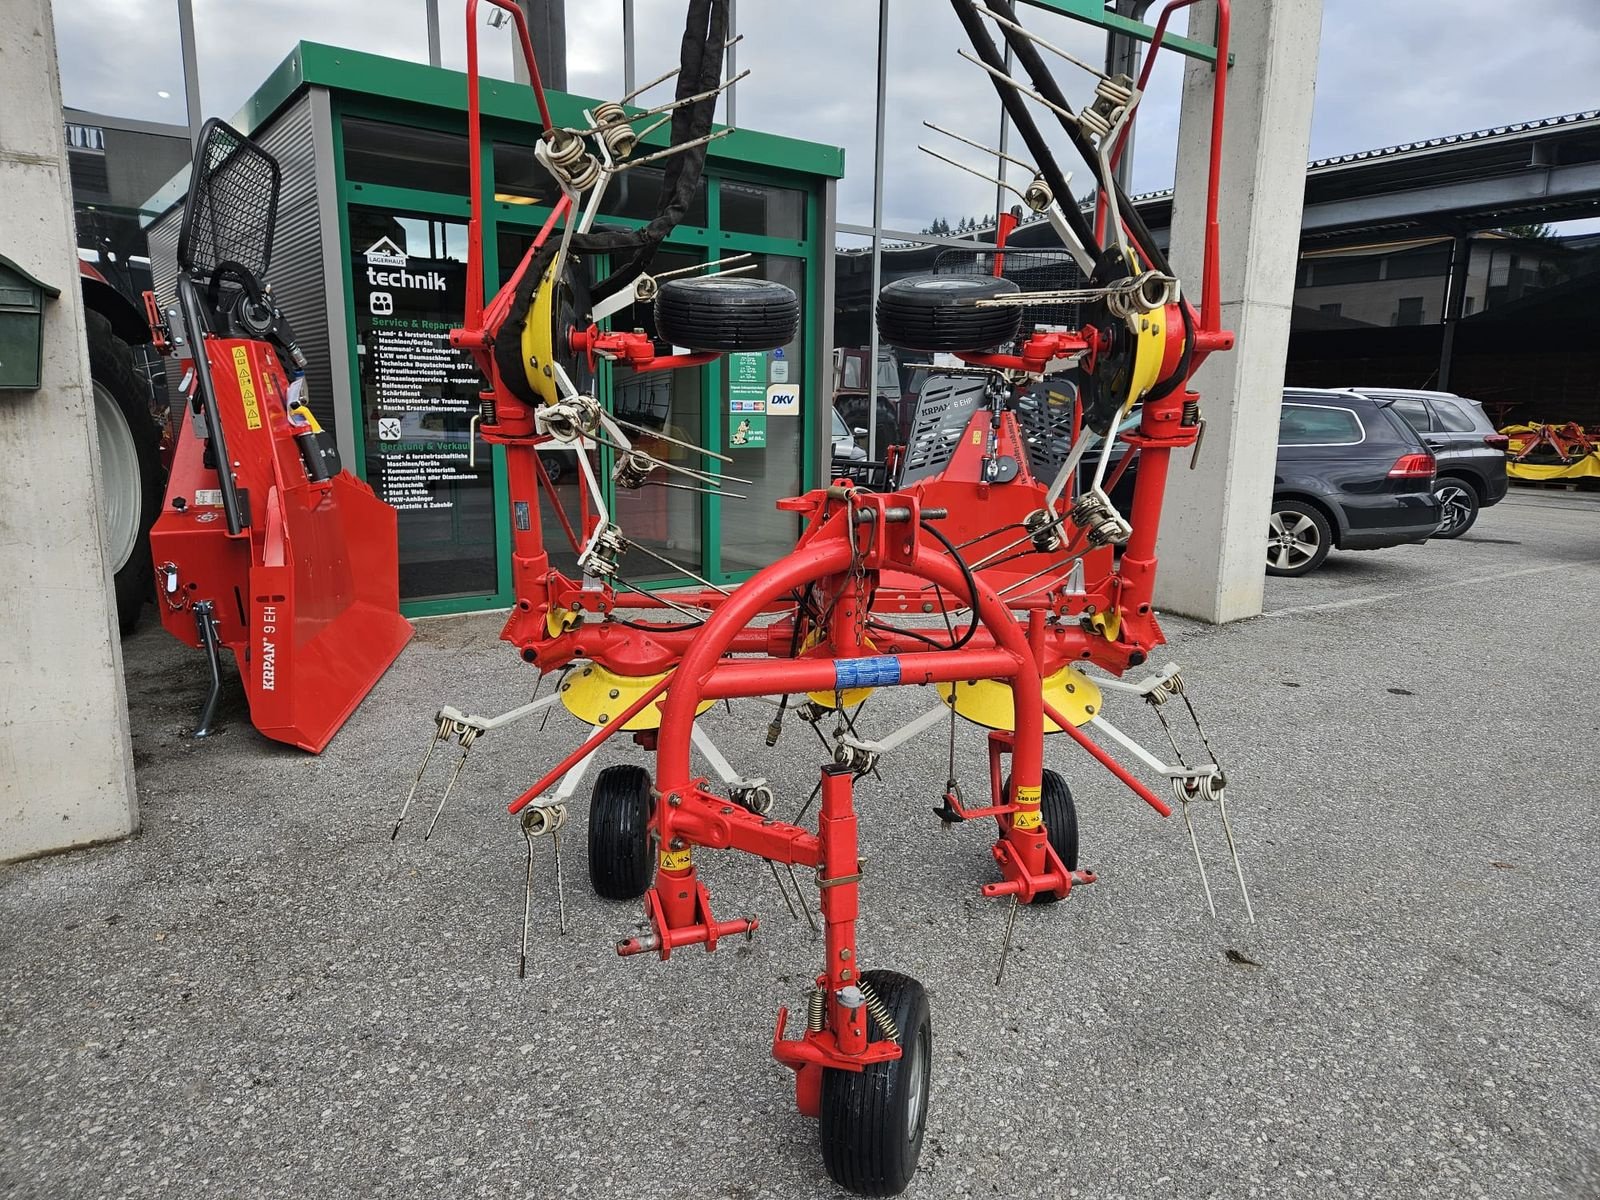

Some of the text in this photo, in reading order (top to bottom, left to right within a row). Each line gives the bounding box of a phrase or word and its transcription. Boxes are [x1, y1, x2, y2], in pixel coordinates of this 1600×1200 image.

[367, 267, 446, 291] technik
[372, 318, 464, 330] Service & Reparatu
[379, 338, 433, 346] Maschinen/Geräte
[422, 347, 460, 355] Gartengeräte
[772, 395, 794, 404] DKV
[380, 442, 423, 451] Beratung
[264, 606, 276, 622] EH
[264, 626, 276, 634] 9
